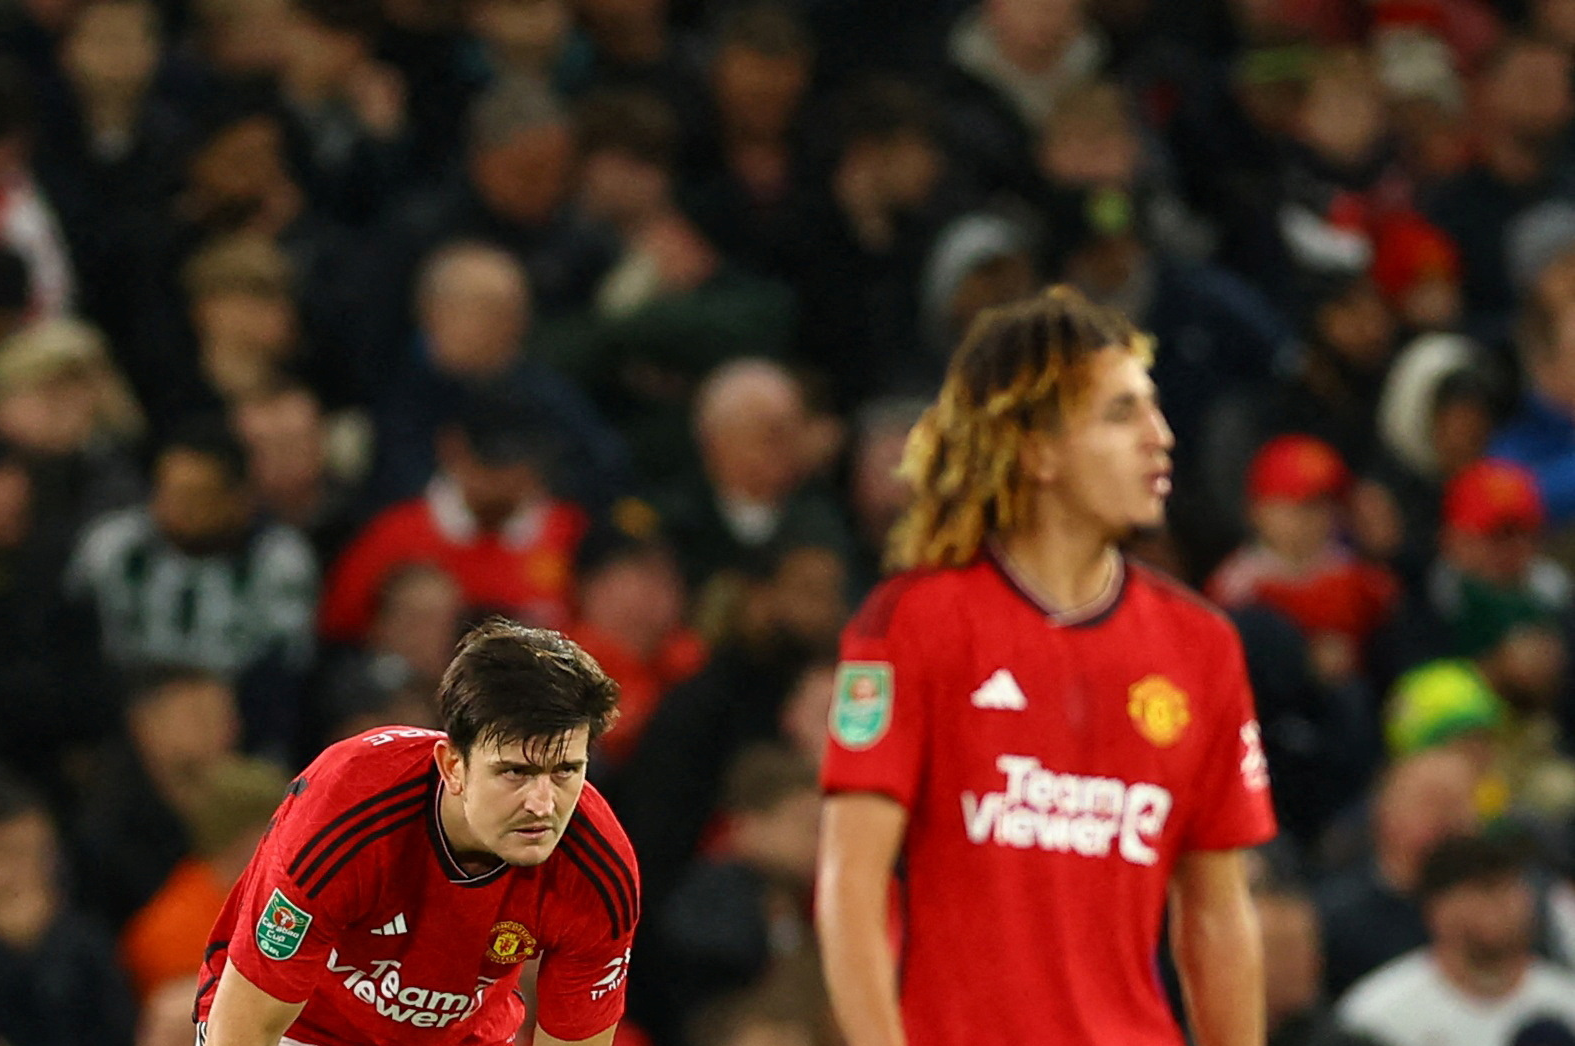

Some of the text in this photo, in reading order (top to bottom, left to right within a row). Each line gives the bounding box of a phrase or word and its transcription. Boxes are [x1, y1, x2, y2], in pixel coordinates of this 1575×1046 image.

[996, 753, 1126, 820] Team
[960, 789, 1122, 858] Viewer
[326, 947, 461, 1029] Viewer
[370, 959, 470, 1012] Team
